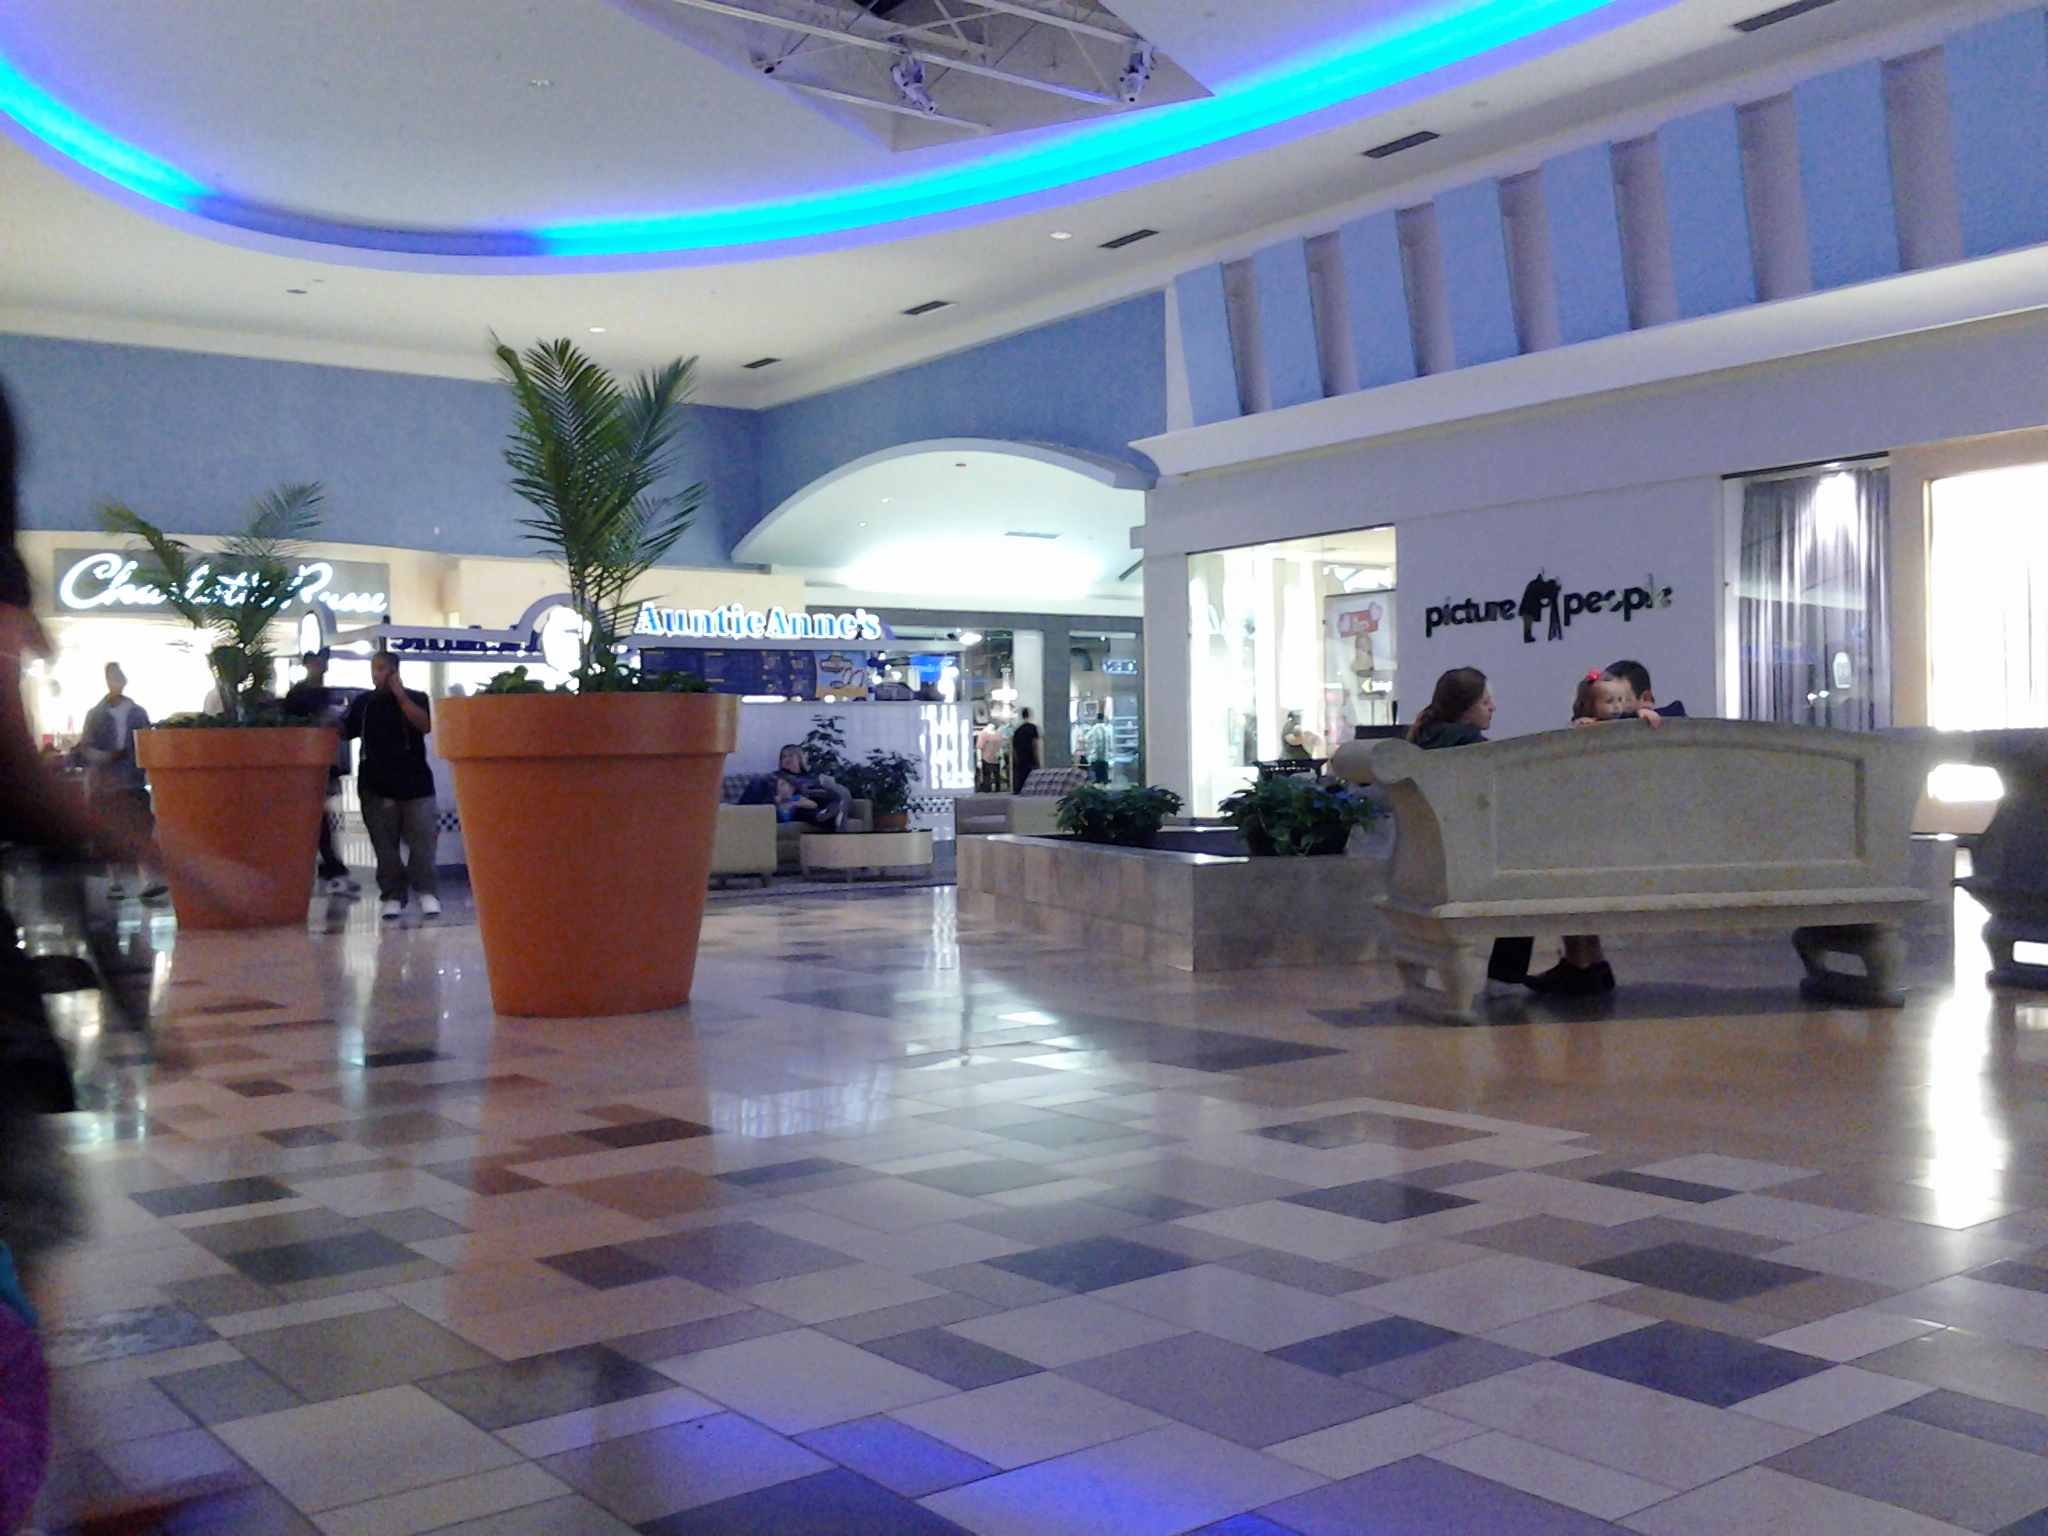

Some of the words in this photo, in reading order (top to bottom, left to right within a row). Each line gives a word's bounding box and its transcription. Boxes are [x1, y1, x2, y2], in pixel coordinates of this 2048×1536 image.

[60, 552, 276, 610] Chaltt
[1425, 596, 1516, 638] picture
[1563, 573, 1673, 627] people
[634, 601, 768, 639] Auntie
[765, 605, 882, 640] Anne's
